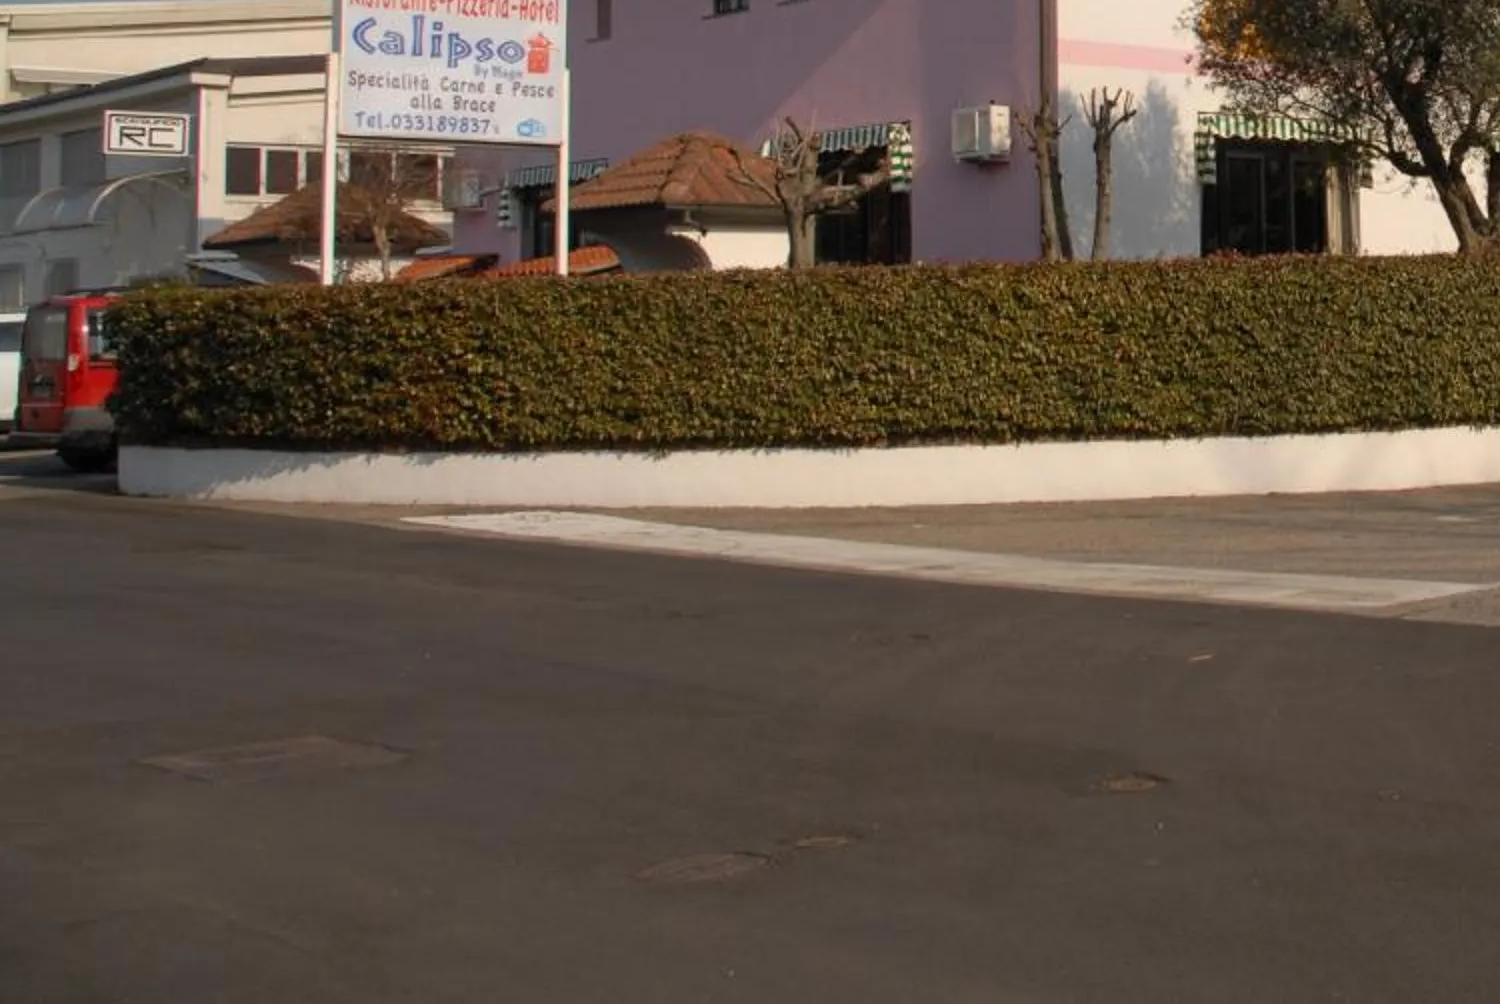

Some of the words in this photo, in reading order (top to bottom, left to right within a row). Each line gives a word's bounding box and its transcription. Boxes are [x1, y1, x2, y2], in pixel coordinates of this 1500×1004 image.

[352, 14, 525, 68] Calipso
[440, 76, 485, 94] Carne
[512, 81, 554, 98] Pesce
[410, 94, 442, 110] alla
[453, 96, 496, 113] Brace
[119, 126, 175, 148] RC
